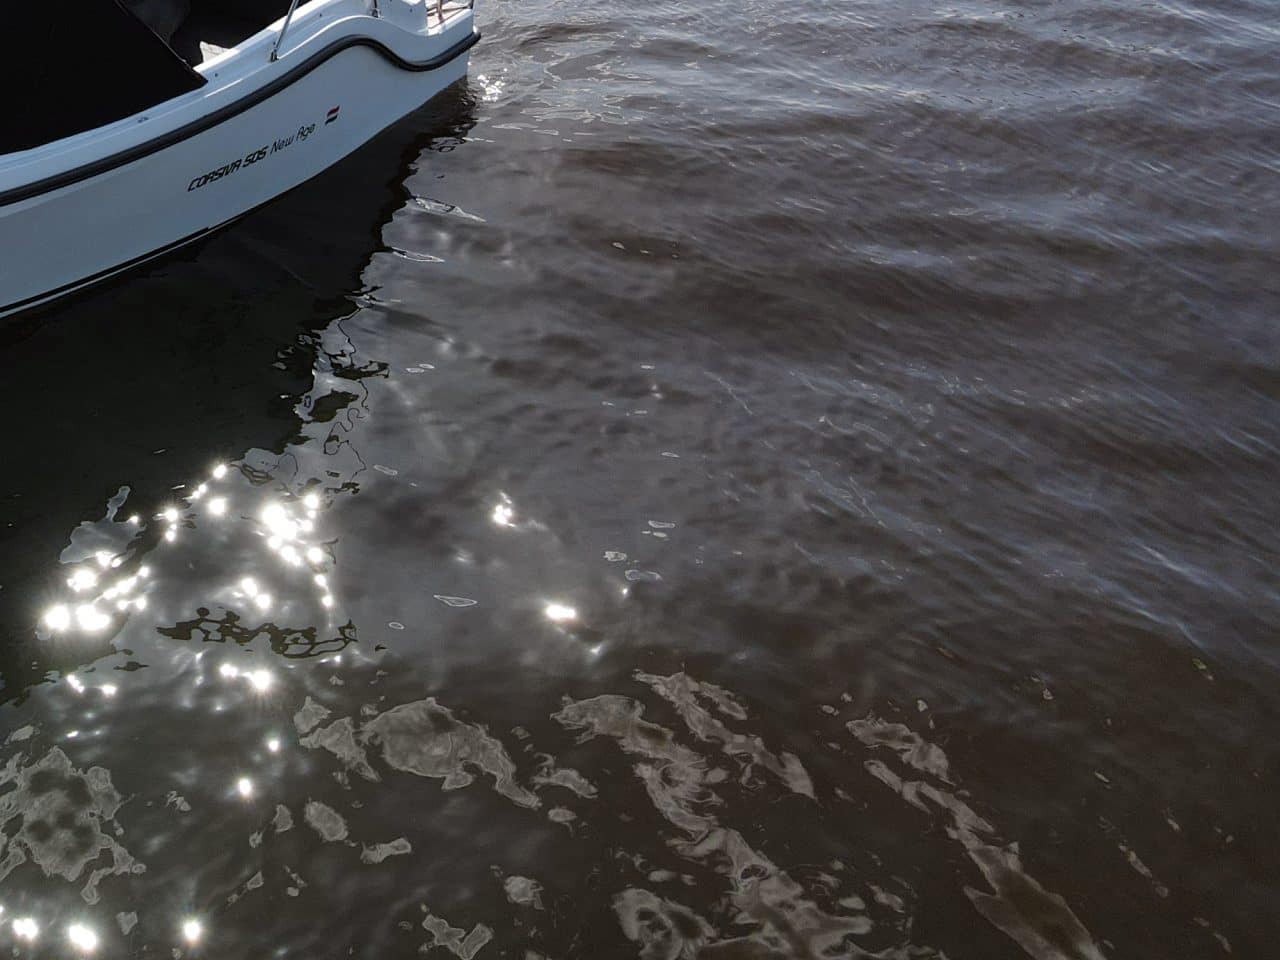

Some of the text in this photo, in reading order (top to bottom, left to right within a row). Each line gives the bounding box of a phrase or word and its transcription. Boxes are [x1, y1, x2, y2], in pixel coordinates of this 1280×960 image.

[188, 159, 242, 192] CORSIVA
[270, 135, 295, 155] New
[295, 123, 316, 142] Age
